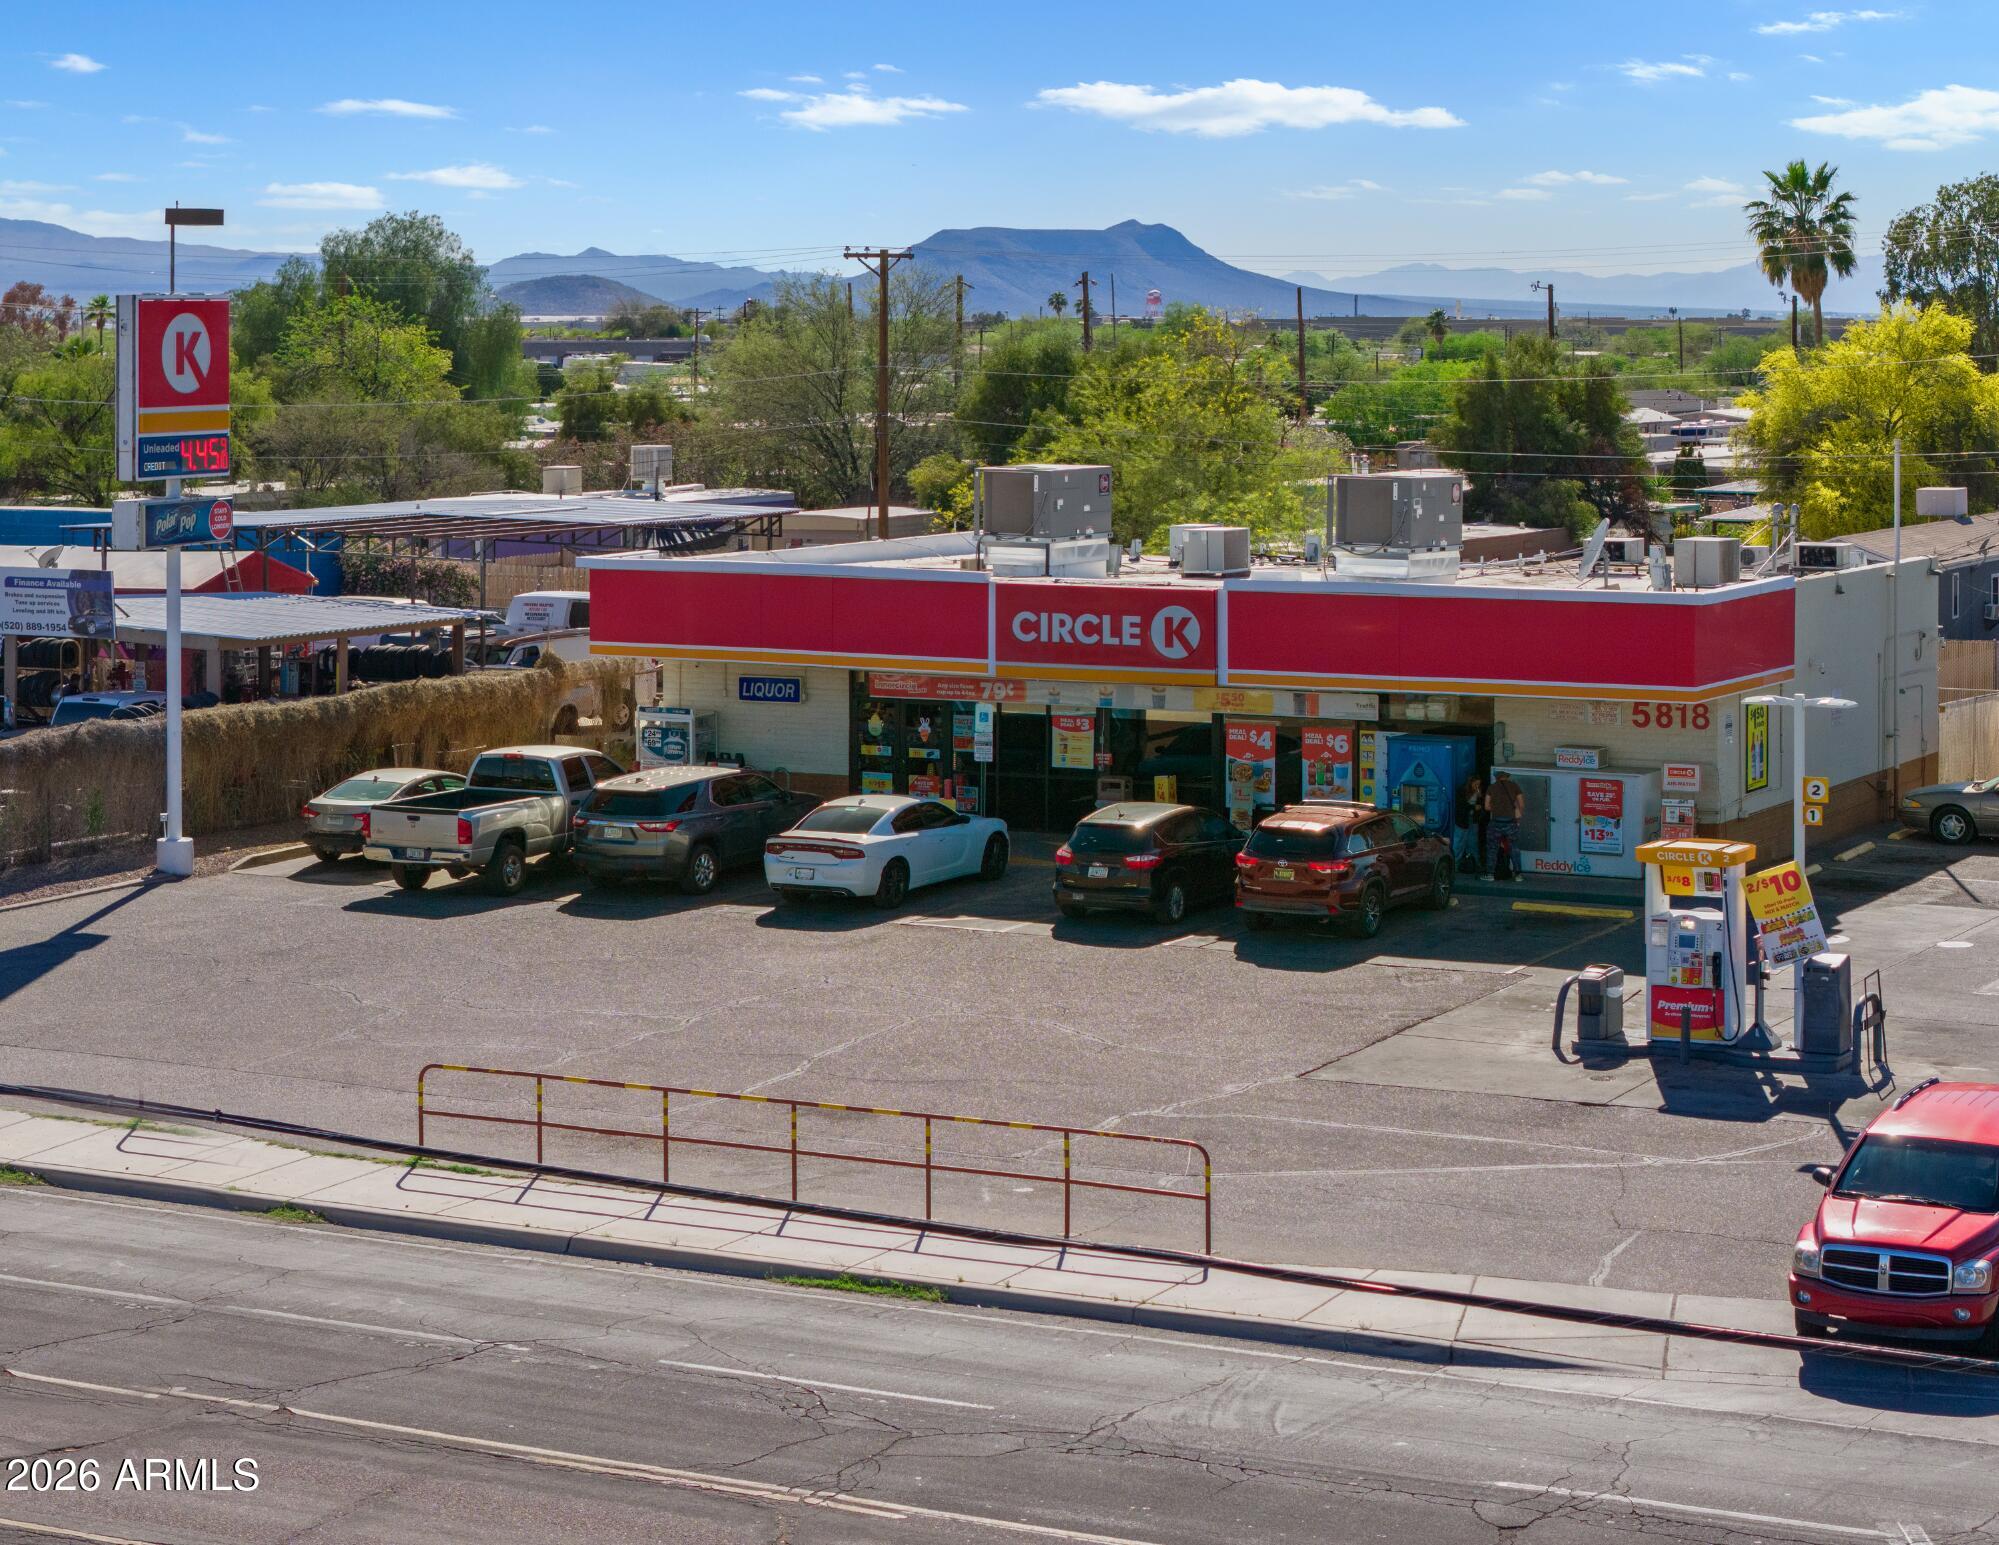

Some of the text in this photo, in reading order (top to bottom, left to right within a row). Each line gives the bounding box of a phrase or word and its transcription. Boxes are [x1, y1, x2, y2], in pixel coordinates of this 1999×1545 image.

[172, 327, 208, 390] K
[143, 442, 180, 454] Unleaded
[143, 461, 166, 472] CREDIT
[156, 513, 196, 535] Polar Pop
[14, 579, 82, 589] Finance Available
[12, 607, 35, 615] Leveling
[1, 621, 67, 632] (520) 889-1954
[1012, 611, 1198, 659] CIRCLE K
[742, 682, 795, 698] LIQUOR
[1632, 701, 1710, 730] 5818
[1249, 730, 1272, 750] $4
[1327, 734, 1349, 753] $6
[1811, 784, 1821, 796] 2
[1809, 810, 1816, 821] 1
[1657, 851, 1695, 862] CIRCLE
[1747, 870, 1802, 896] 2/$10
[1780, 901, 1800, 911] MATCH
[1716, 923, 1723, 931] 2
